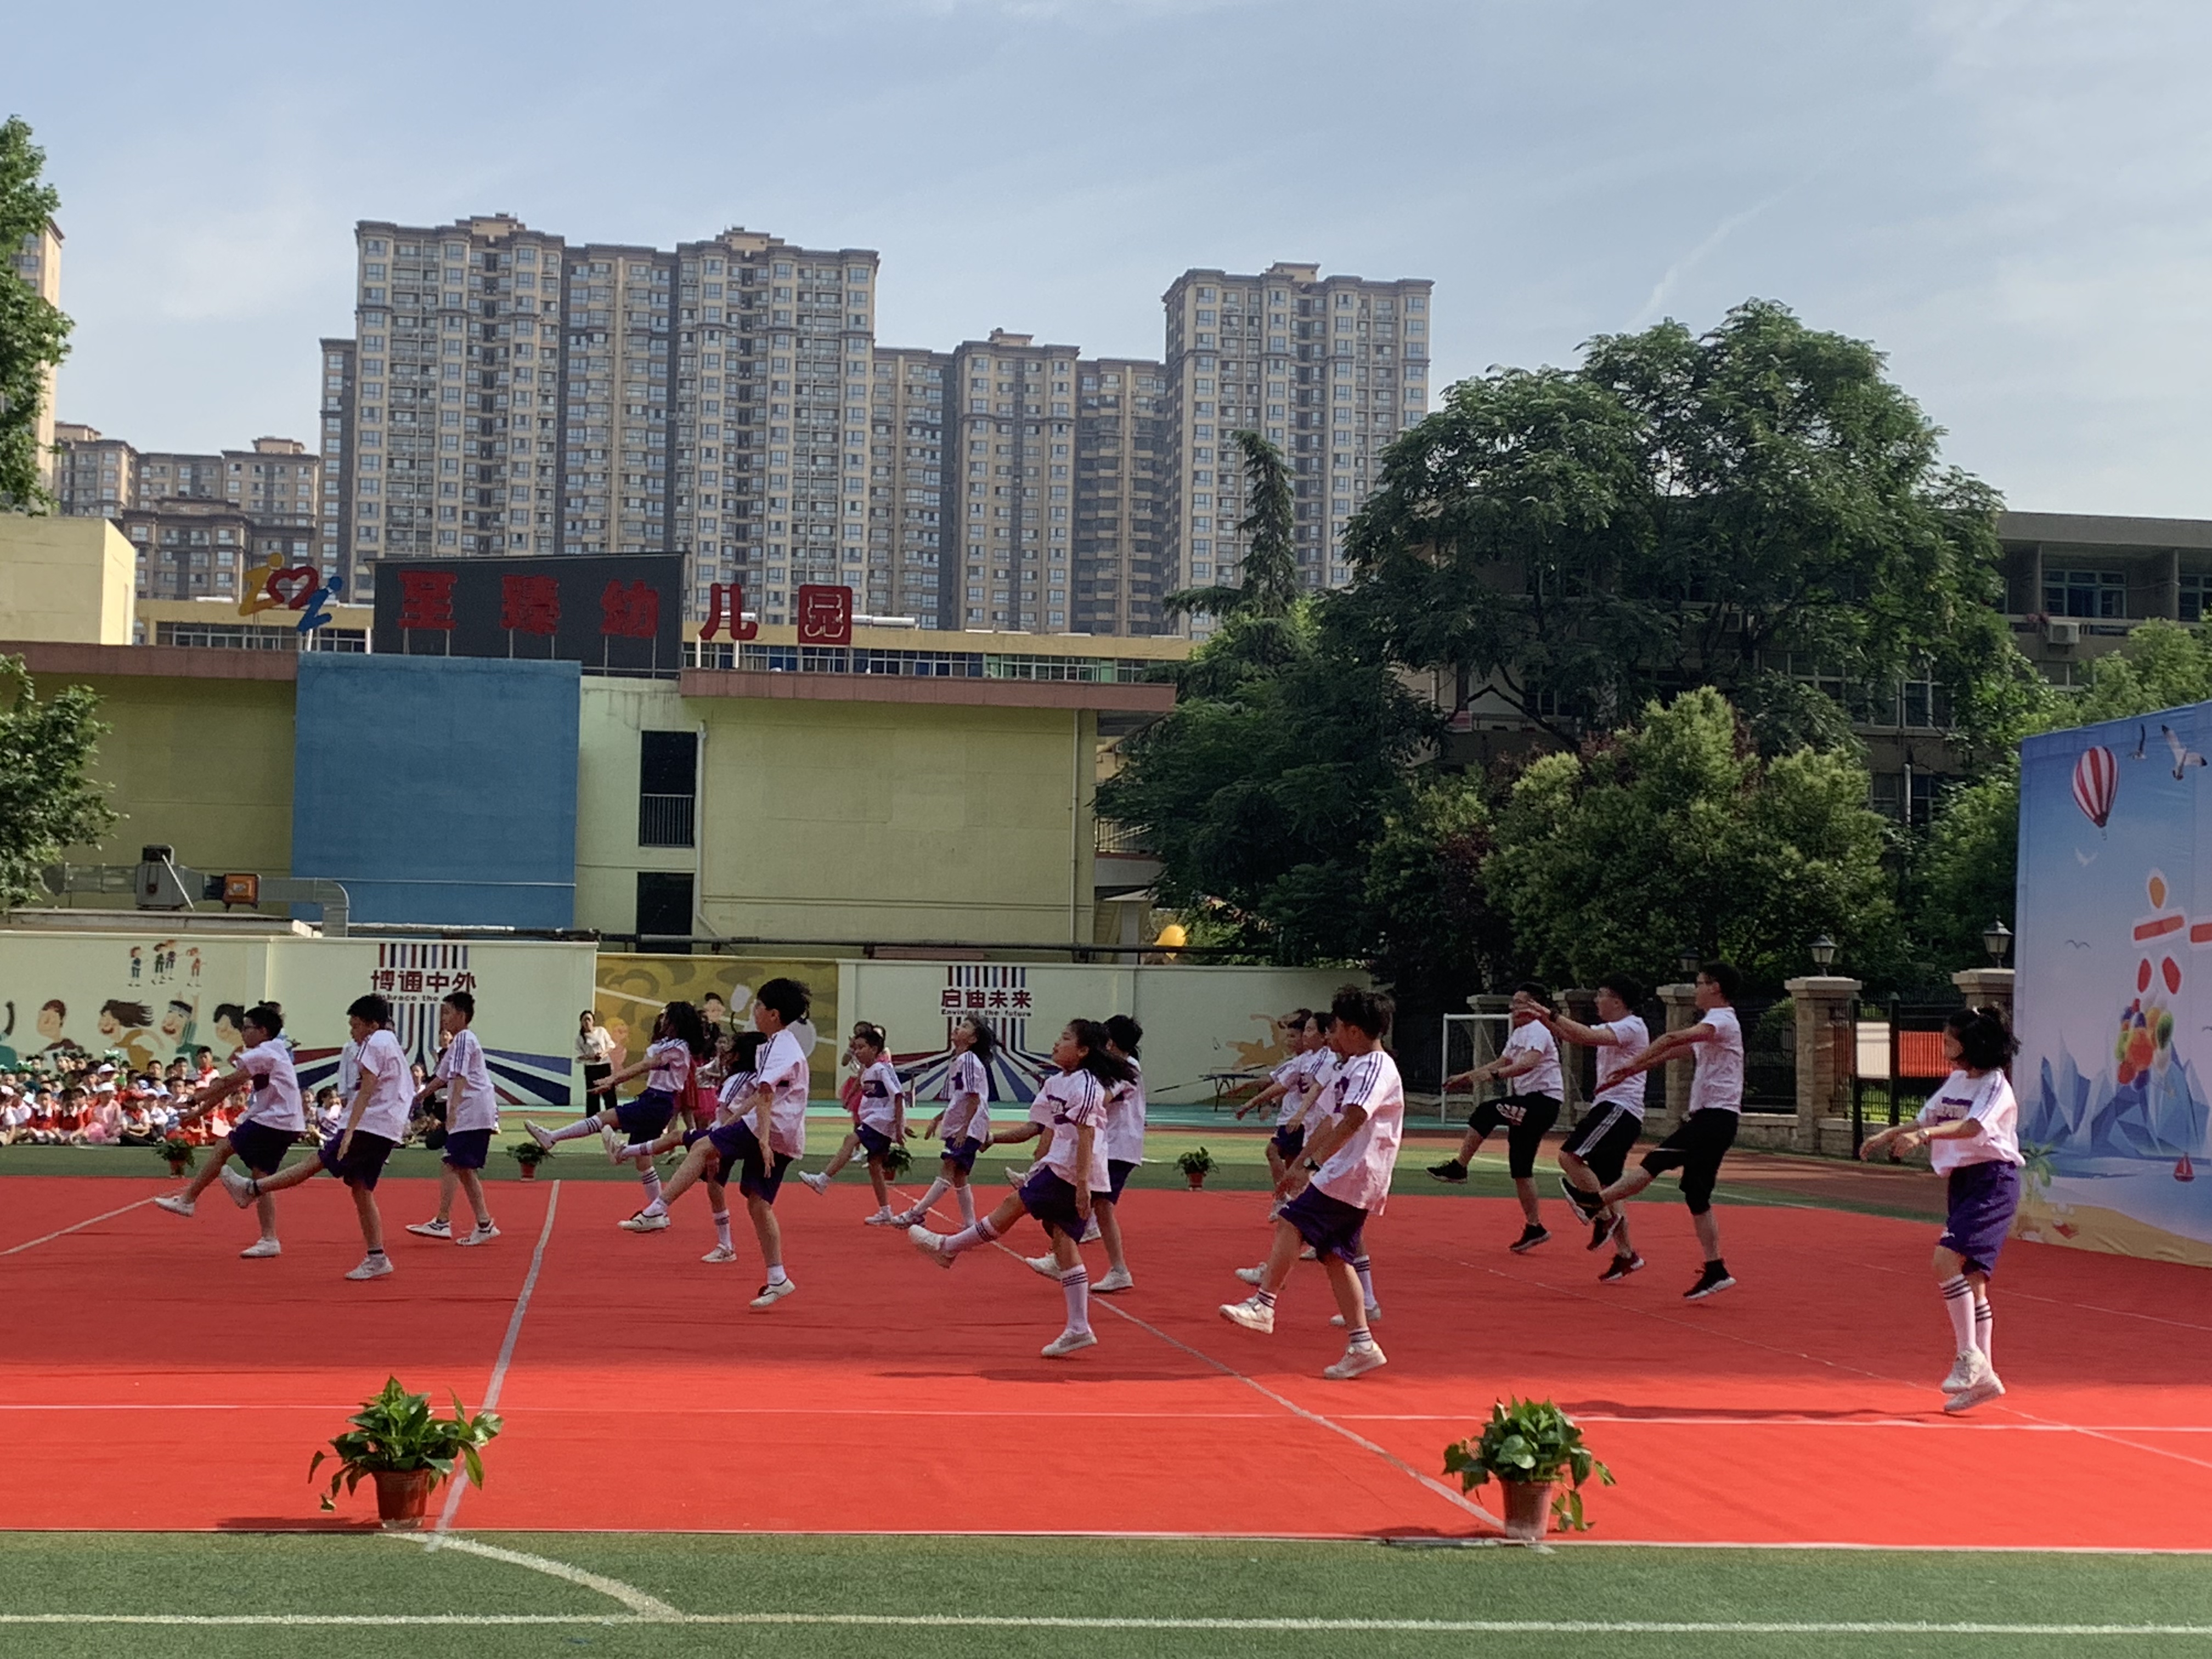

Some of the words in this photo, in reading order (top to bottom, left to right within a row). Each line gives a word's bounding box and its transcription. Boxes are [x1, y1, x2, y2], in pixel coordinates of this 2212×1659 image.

[370, 969, 477, 994] 博通中外
[940, 988, 1032, 1009] 启迪未来
